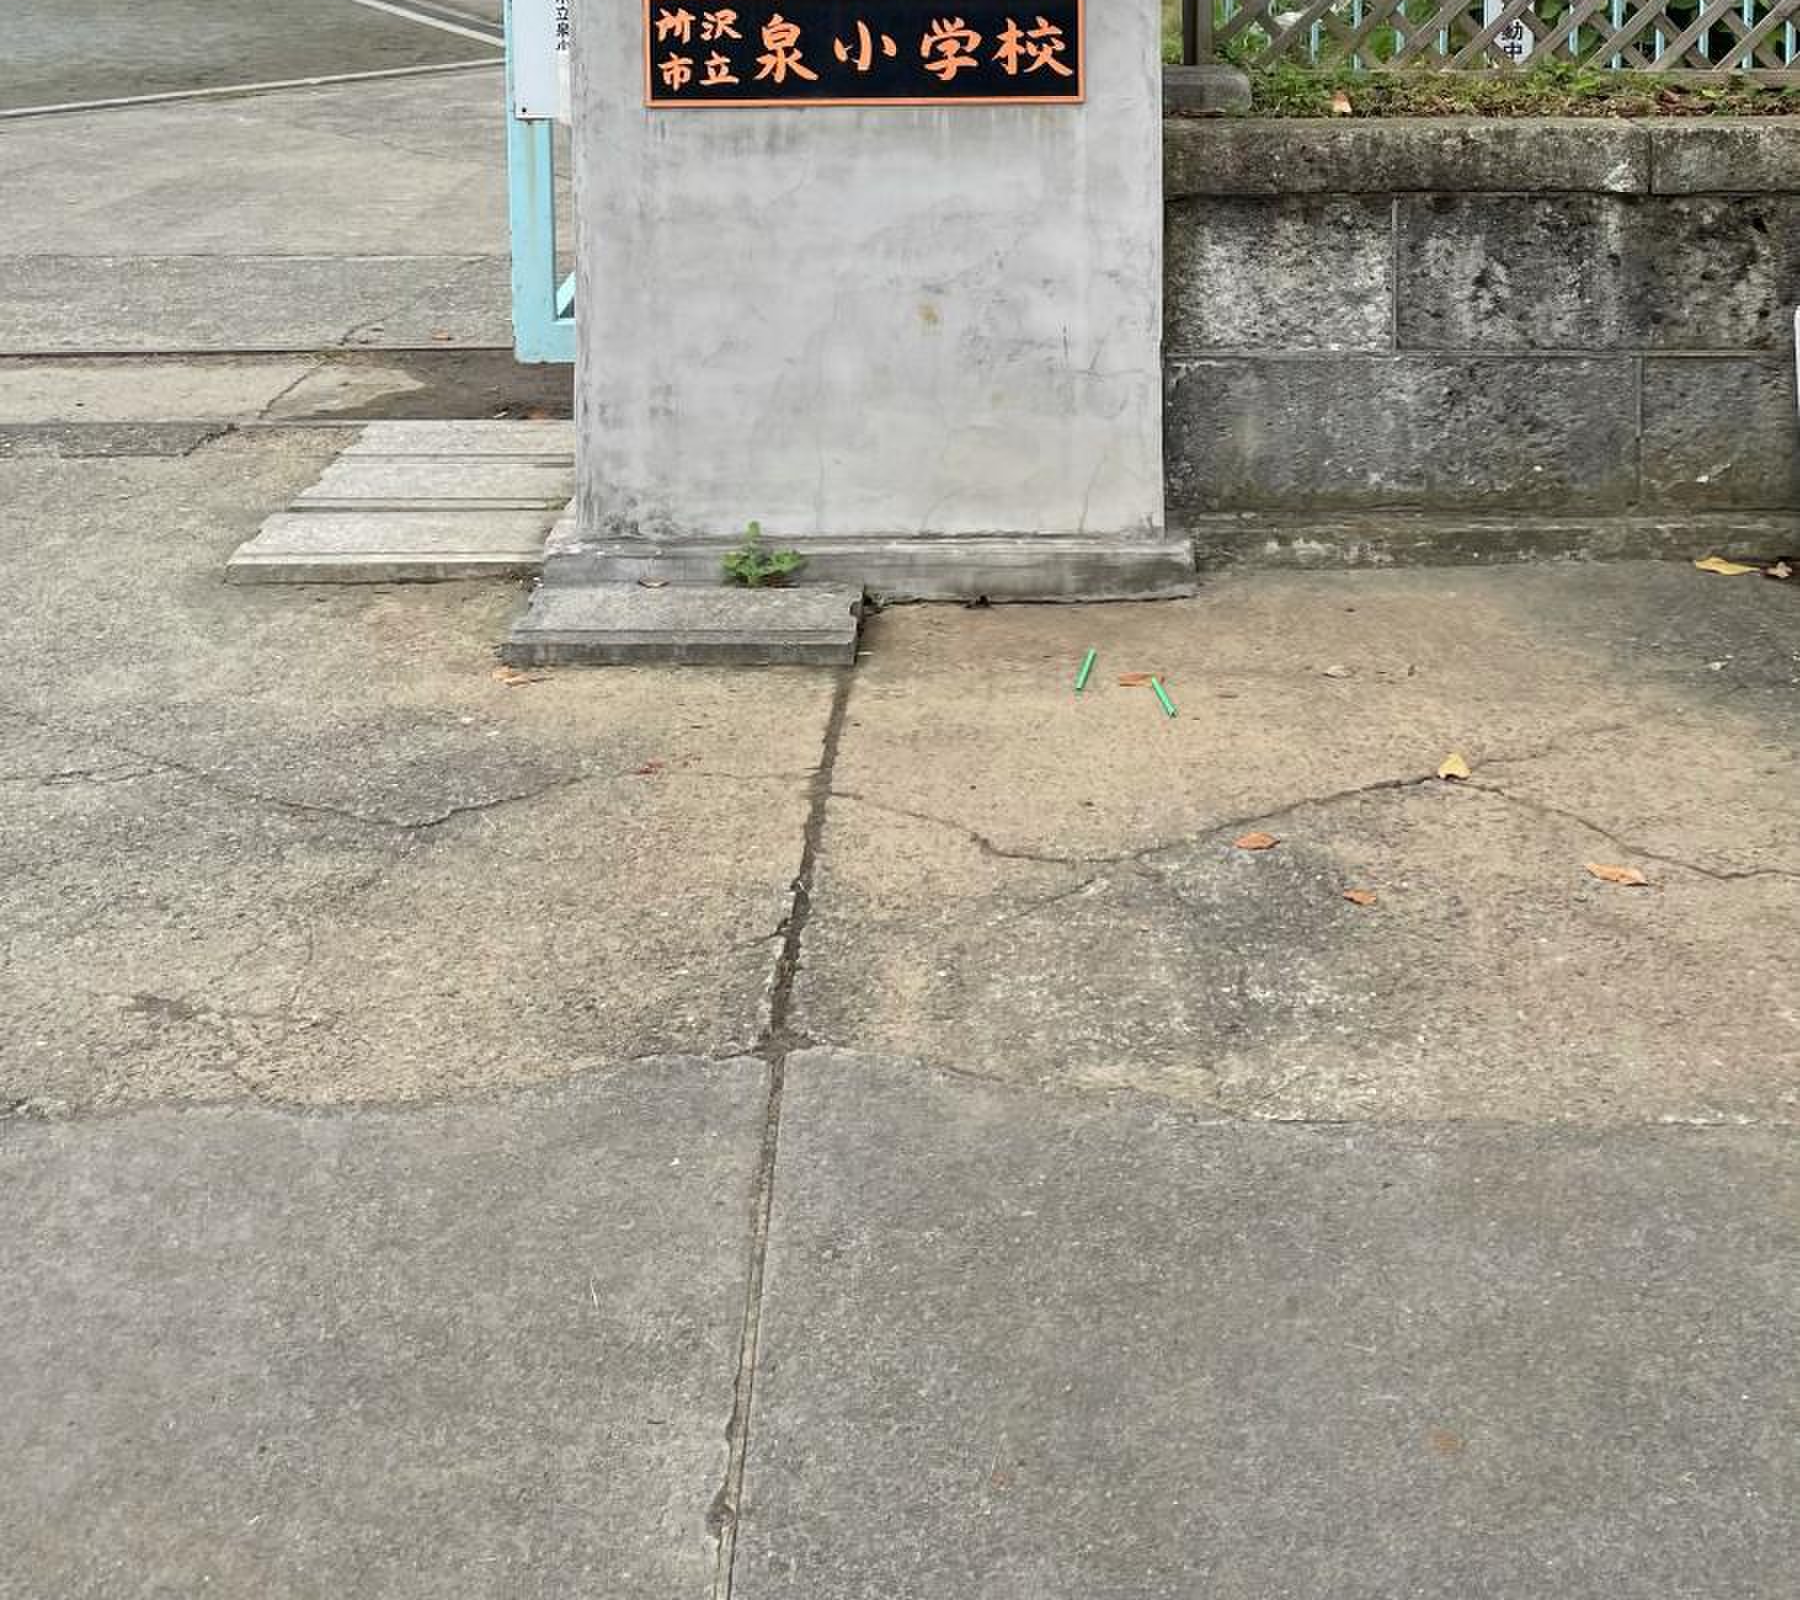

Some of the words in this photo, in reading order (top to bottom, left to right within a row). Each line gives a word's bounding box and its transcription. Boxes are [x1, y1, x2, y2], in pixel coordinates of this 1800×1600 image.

[656, 8, 742, 44] 所沢
[753, 12, 1073, 81] 泉小学校
[657, 51, 739, 90] 市立
